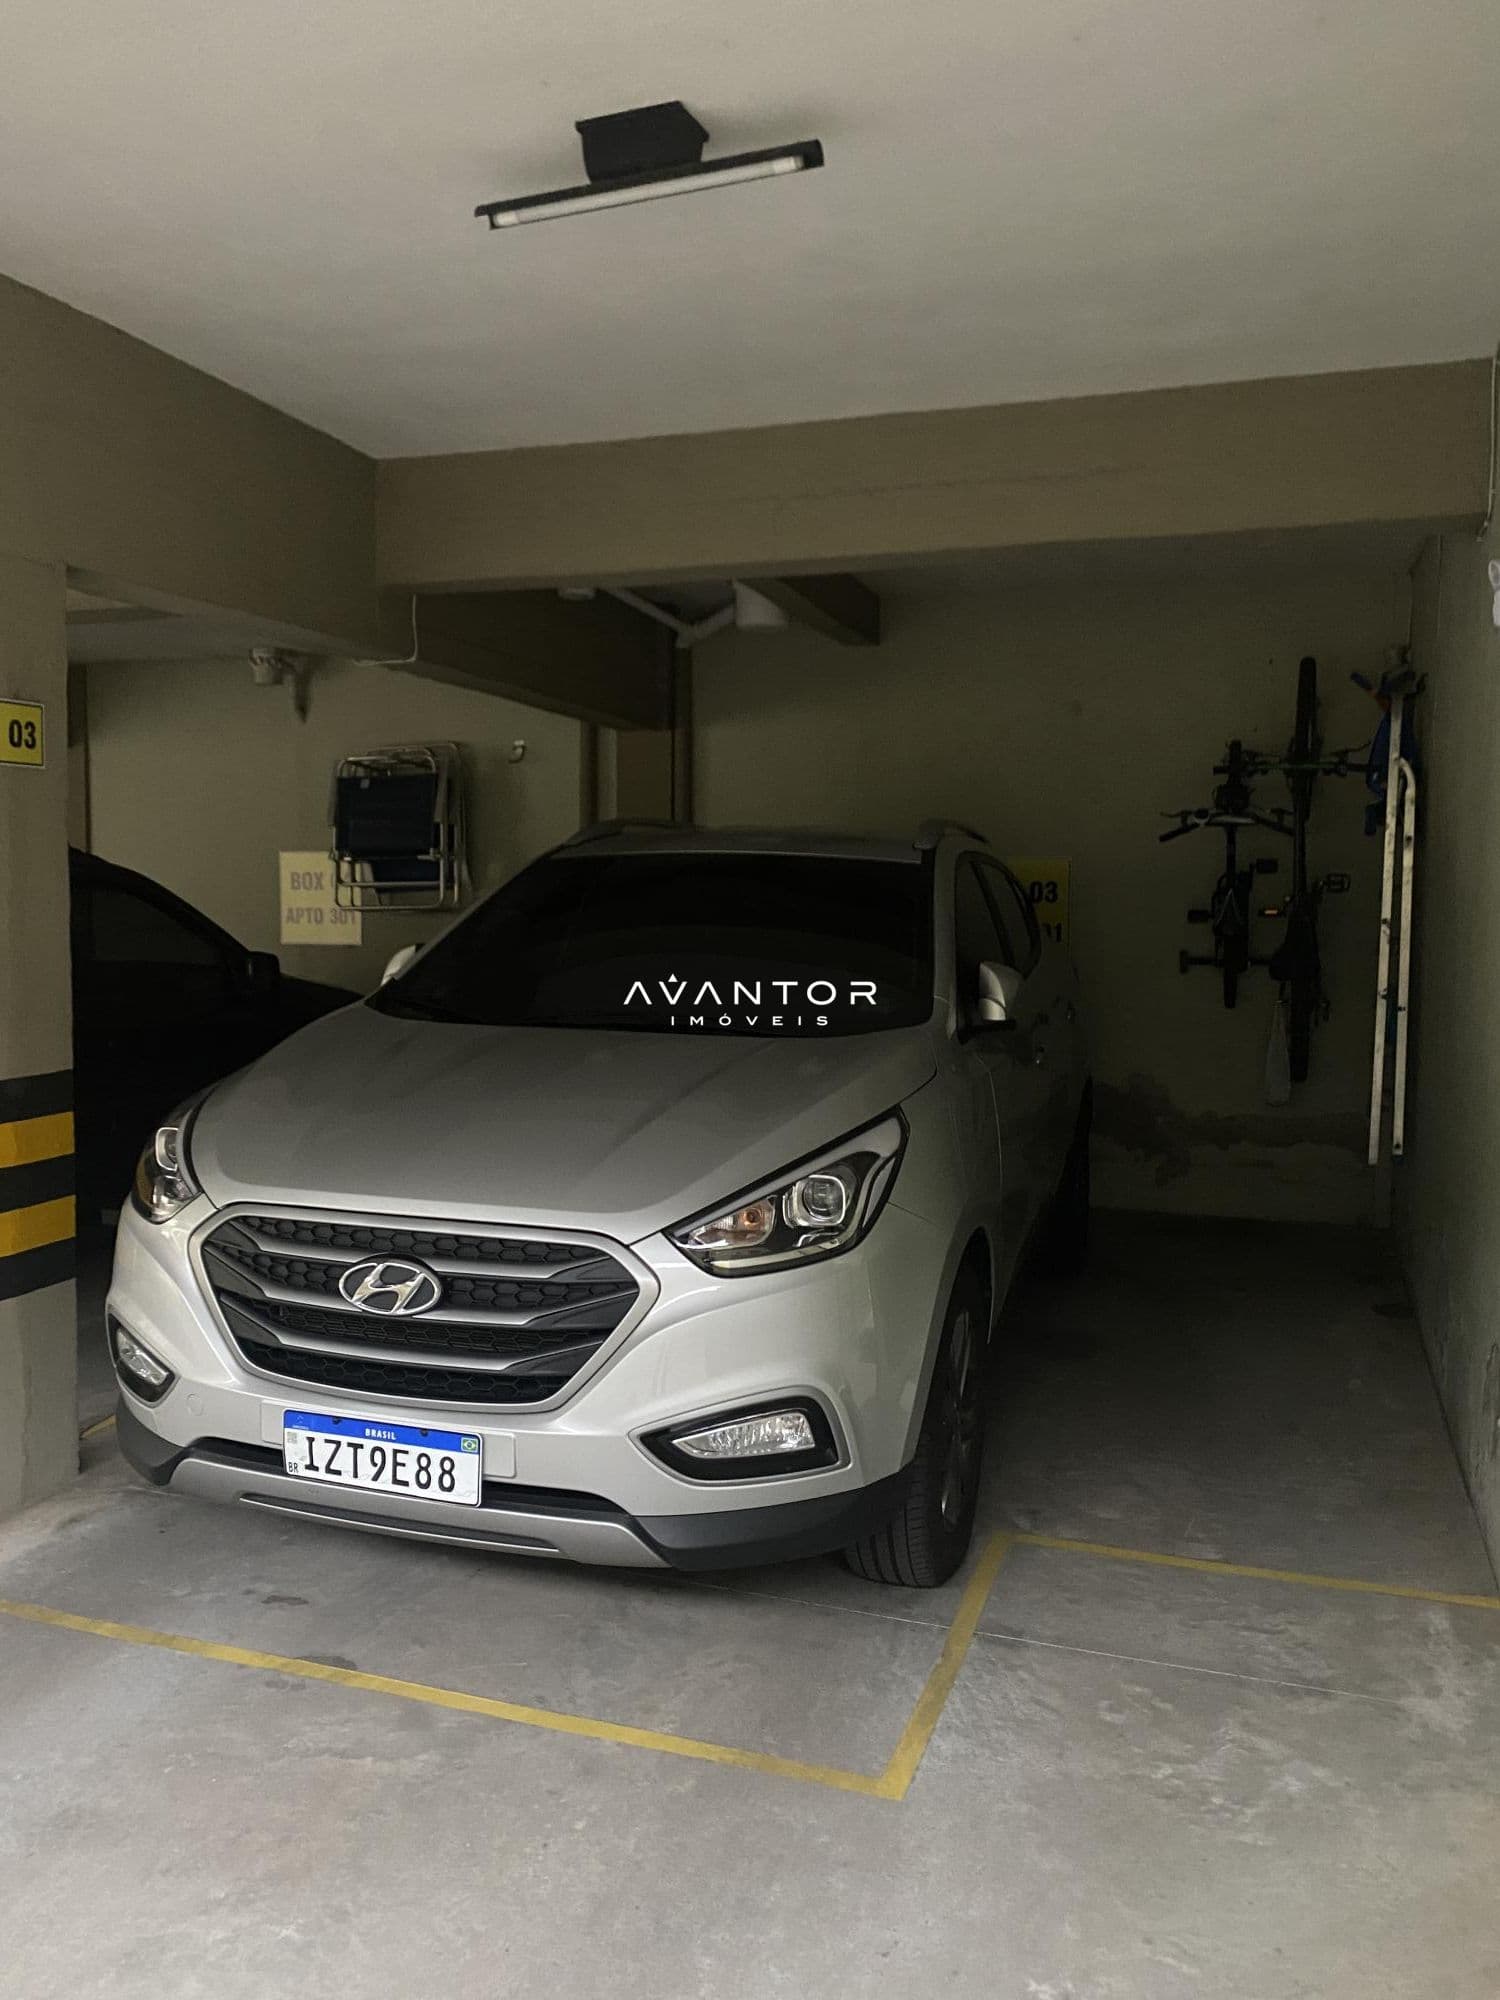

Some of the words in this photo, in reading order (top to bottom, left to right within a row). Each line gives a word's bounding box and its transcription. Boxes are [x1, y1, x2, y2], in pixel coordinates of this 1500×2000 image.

[9, 719, 37, 750] 03
[290, 871, 325, 890] BOX
[1030, 880, 1058, 904] 03
[285, 906, 324, 925] APTO
[329, 907, 356, 925] 301
[364, 1427, 397, 1441] BRASIL
[287, 1461, 299, 1474] BR
[304, 1436, 456, 1494] IZT9E88
